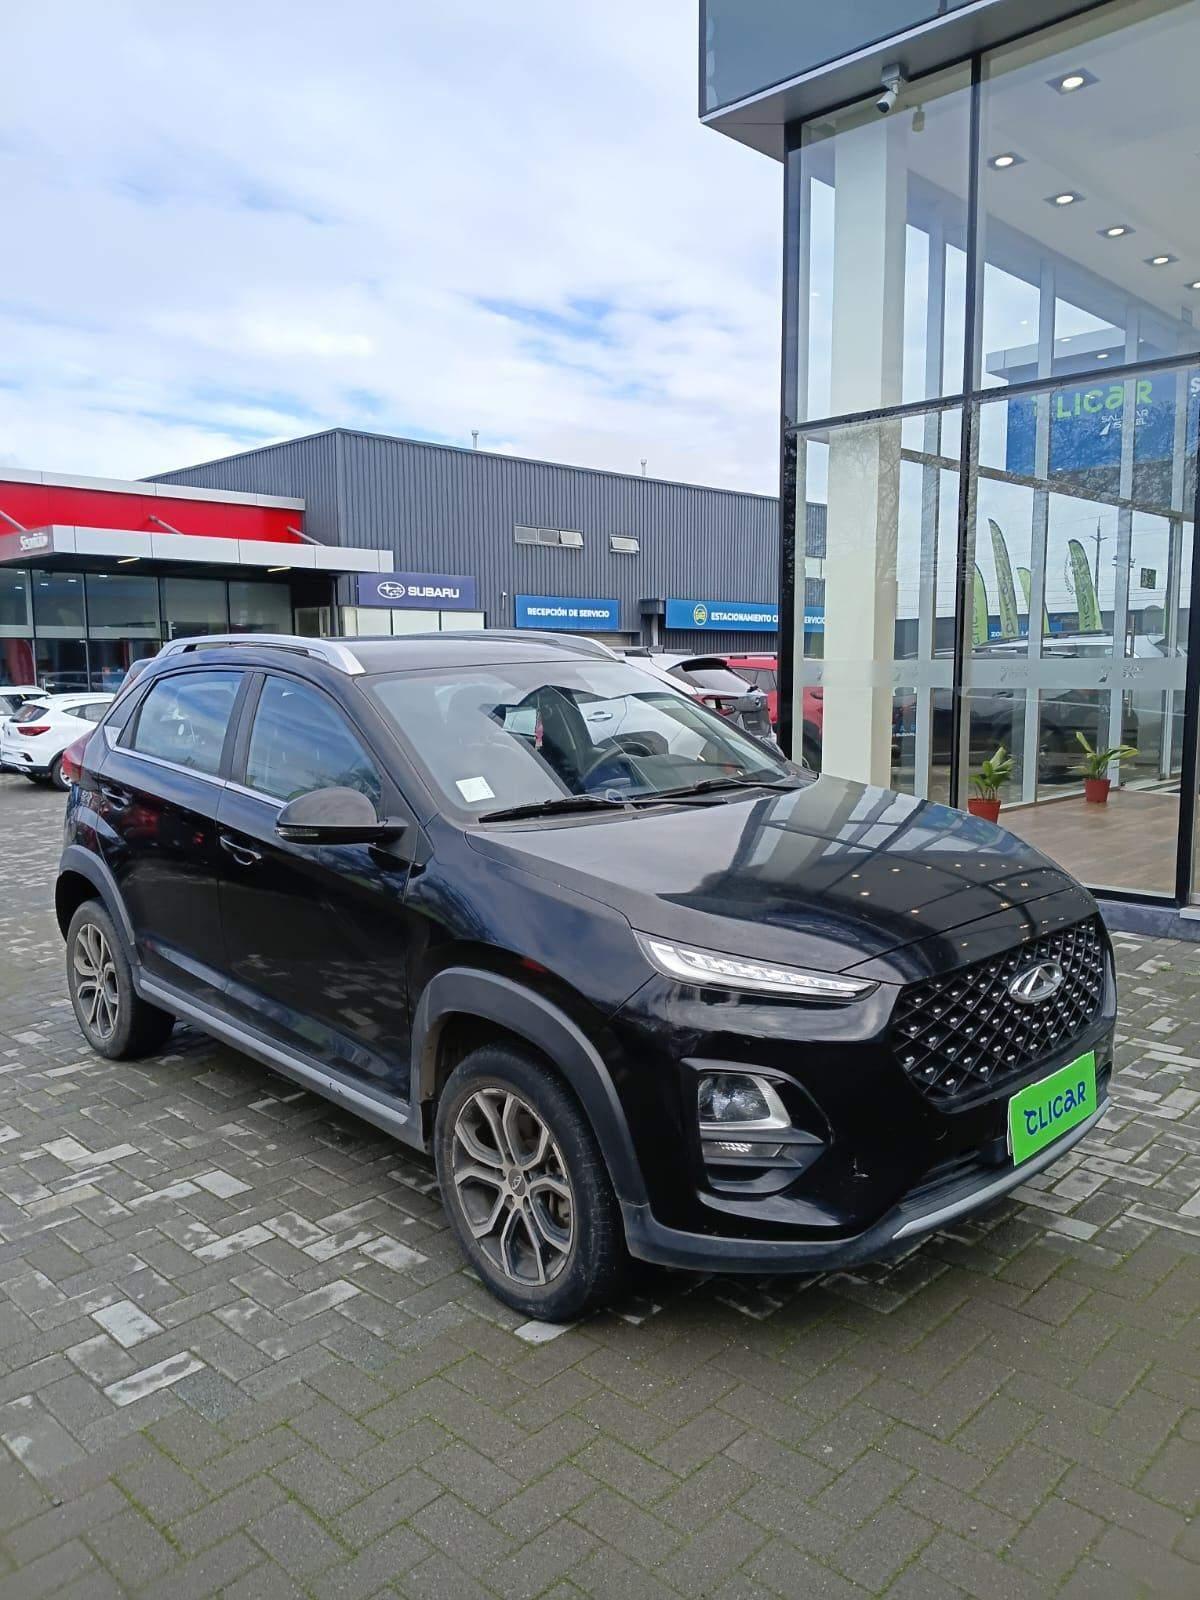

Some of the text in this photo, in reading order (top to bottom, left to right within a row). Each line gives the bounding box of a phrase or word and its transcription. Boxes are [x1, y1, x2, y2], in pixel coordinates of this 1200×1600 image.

[407, 586, 460, 598] SUBARU
[527, 606, 610, 618] RECEPCIÓN DE SERVICIO
[711, 611, 771, 623] ESTACIONAMIENTO
